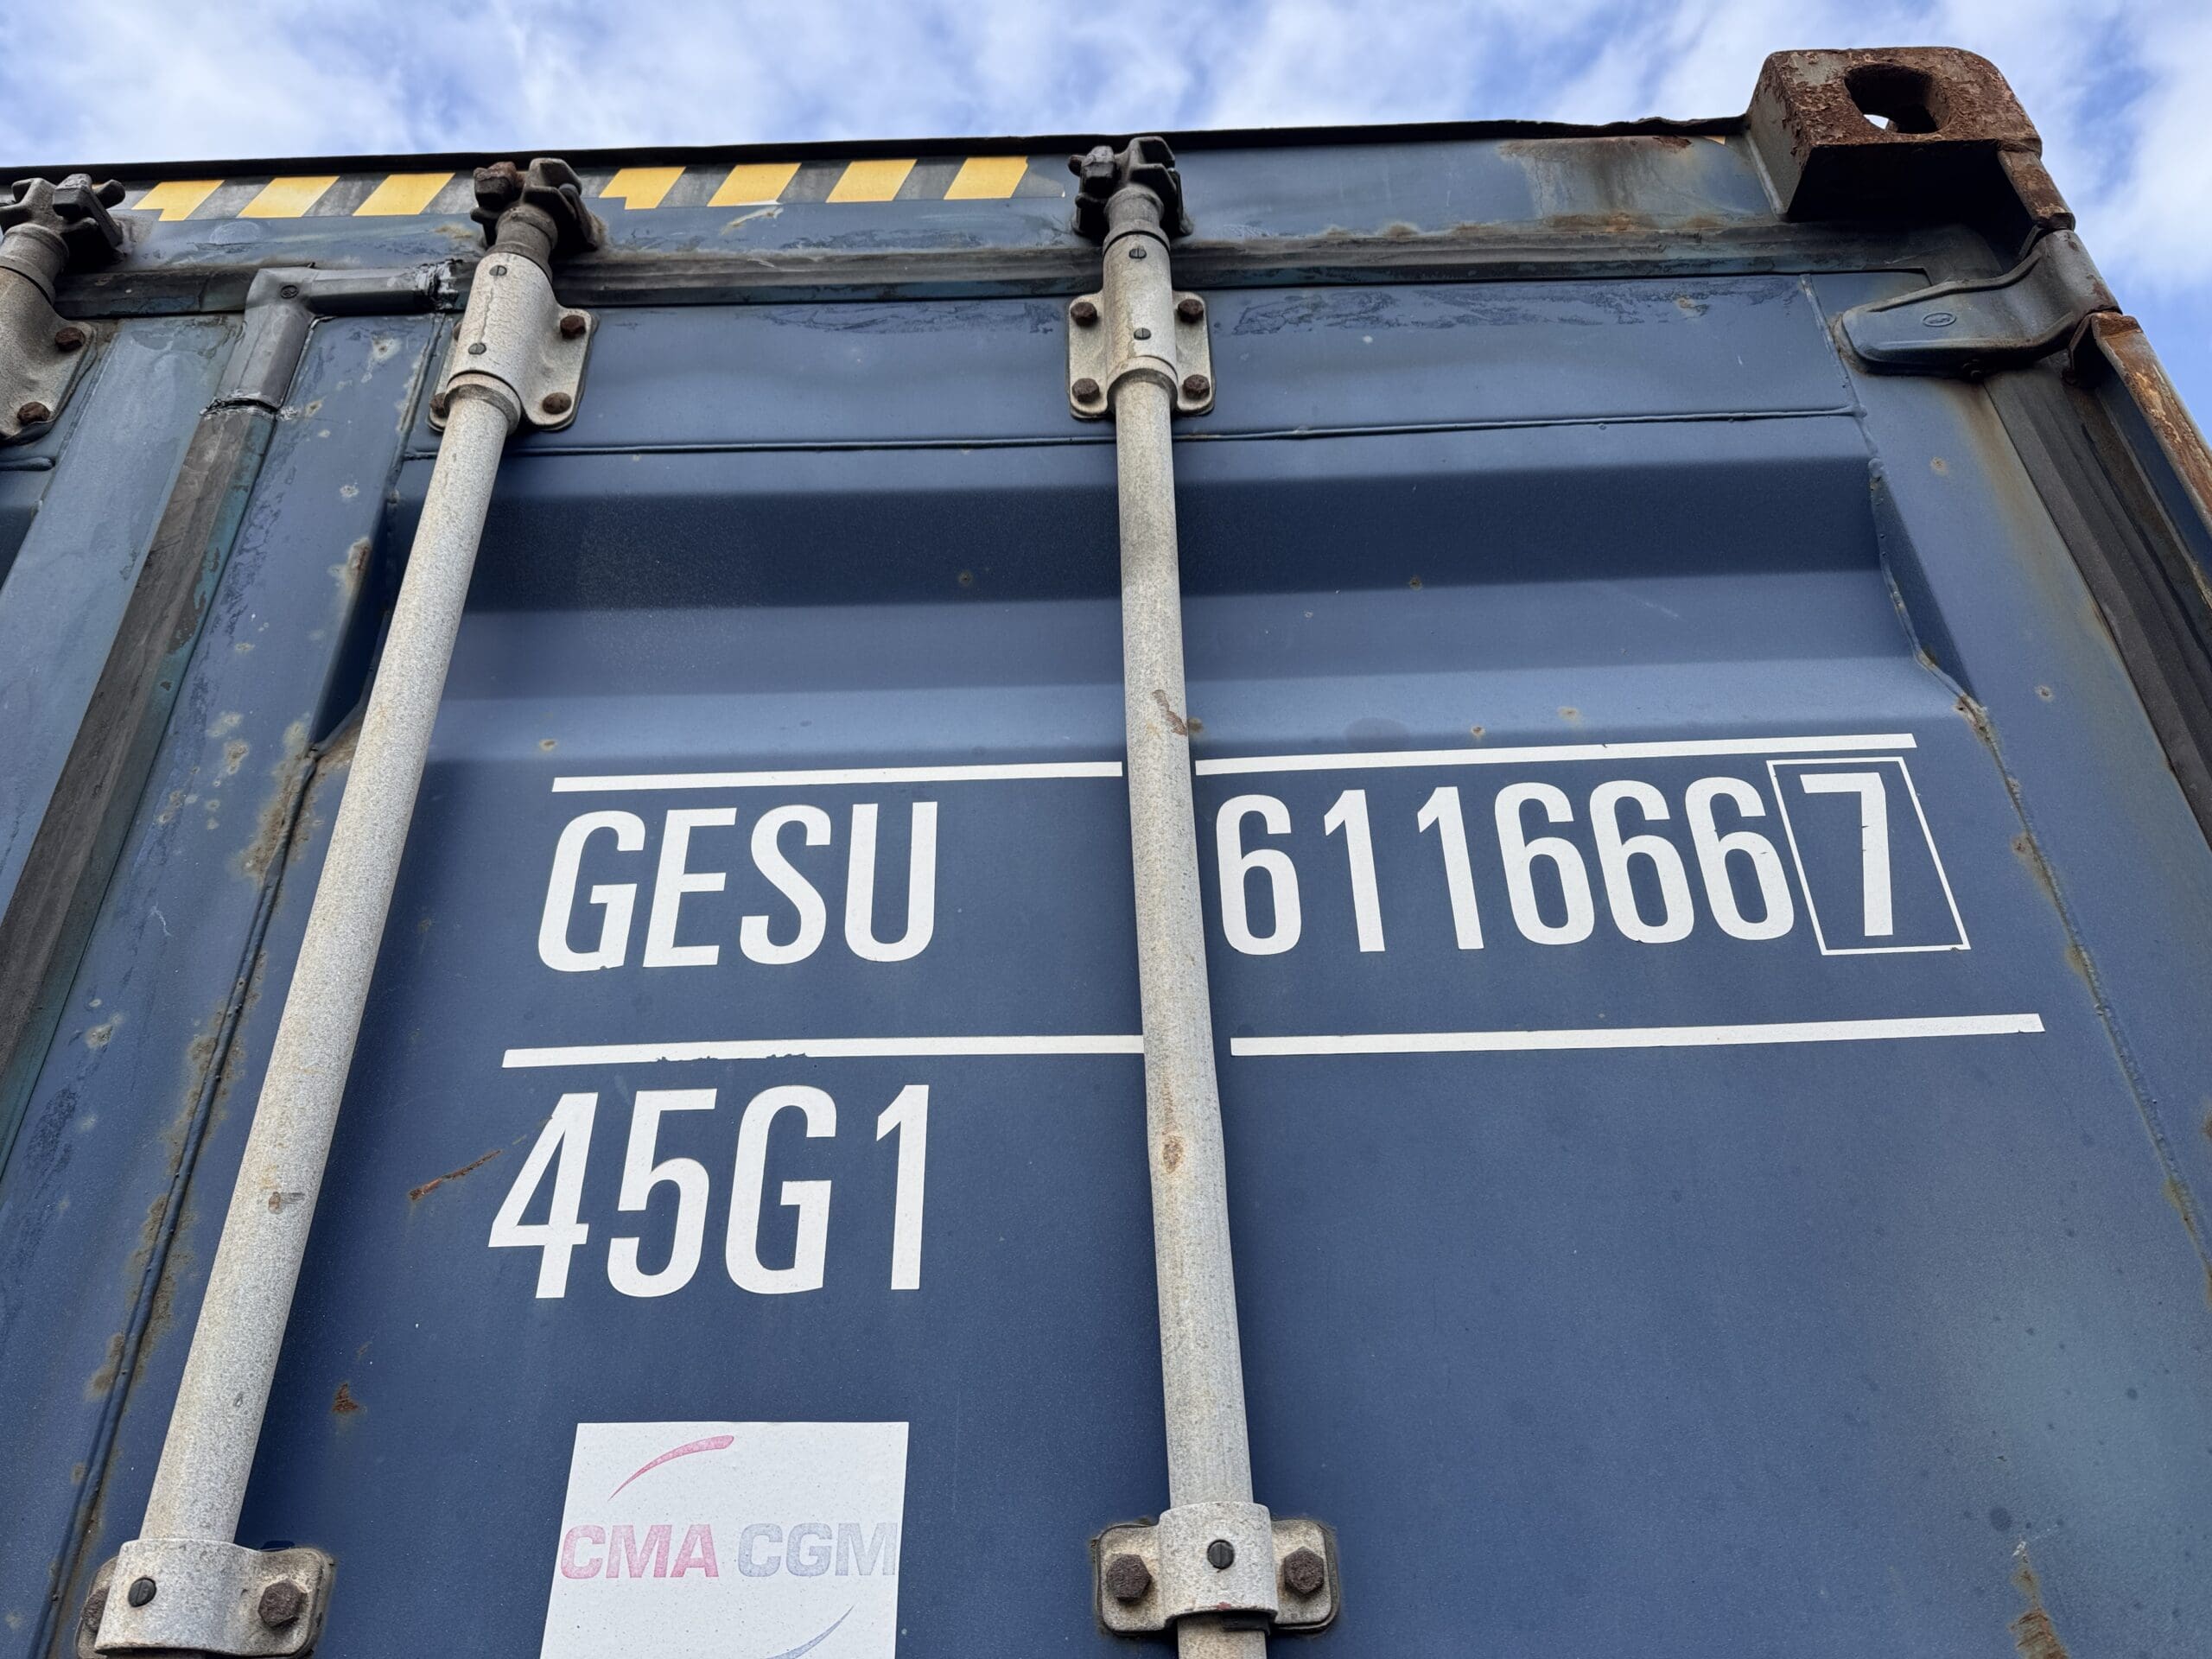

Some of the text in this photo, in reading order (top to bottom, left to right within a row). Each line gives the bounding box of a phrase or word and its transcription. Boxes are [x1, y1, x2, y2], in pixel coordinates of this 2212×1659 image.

[538, 802, 938, 972] GESU
[488, 1085, 930, 1299] 45G1
[561, 1522, 898, 1579] CMA CGM
